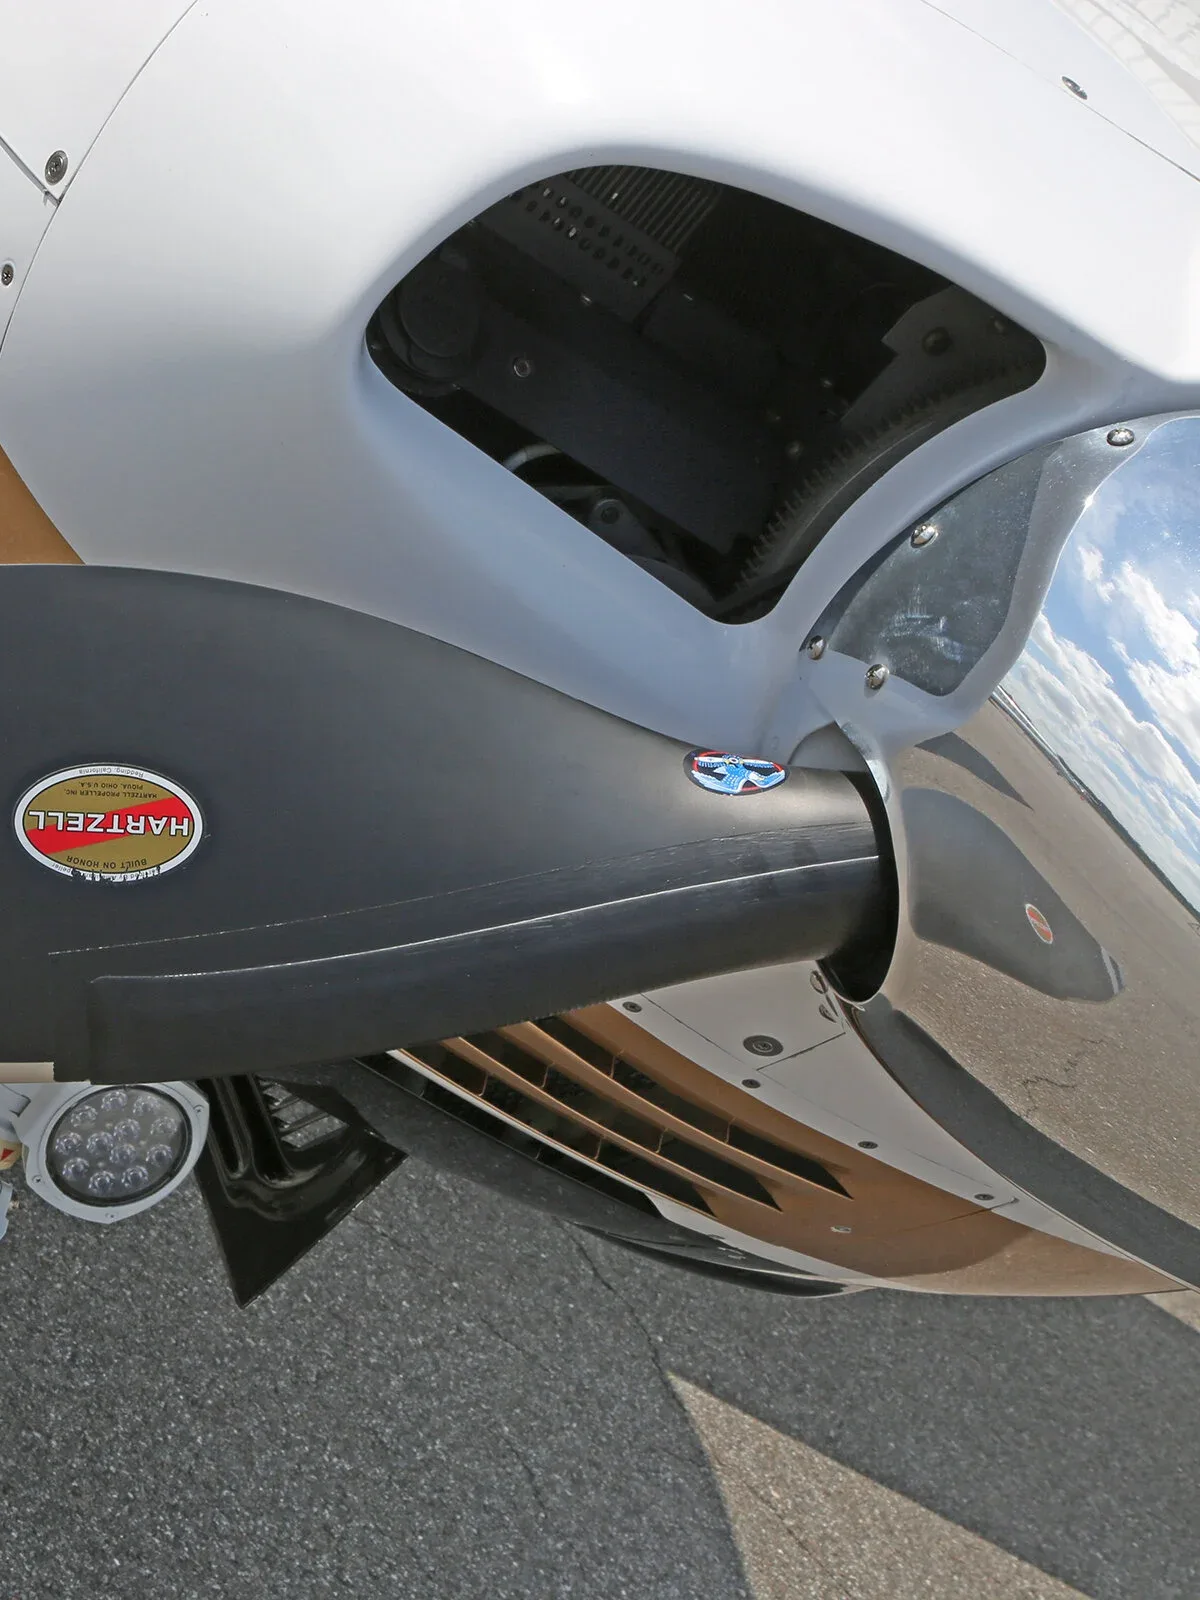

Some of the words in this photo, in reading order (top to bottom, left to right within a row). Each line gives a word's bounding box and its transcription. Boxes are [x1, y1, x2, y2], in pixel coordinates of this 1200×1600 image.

[28, 810, 190, 837] HARTZELL
[66, 855, 99, 869] HONOR
[103, 862, 117, 870] ON
[120, 858, 147, 870] BUILT
